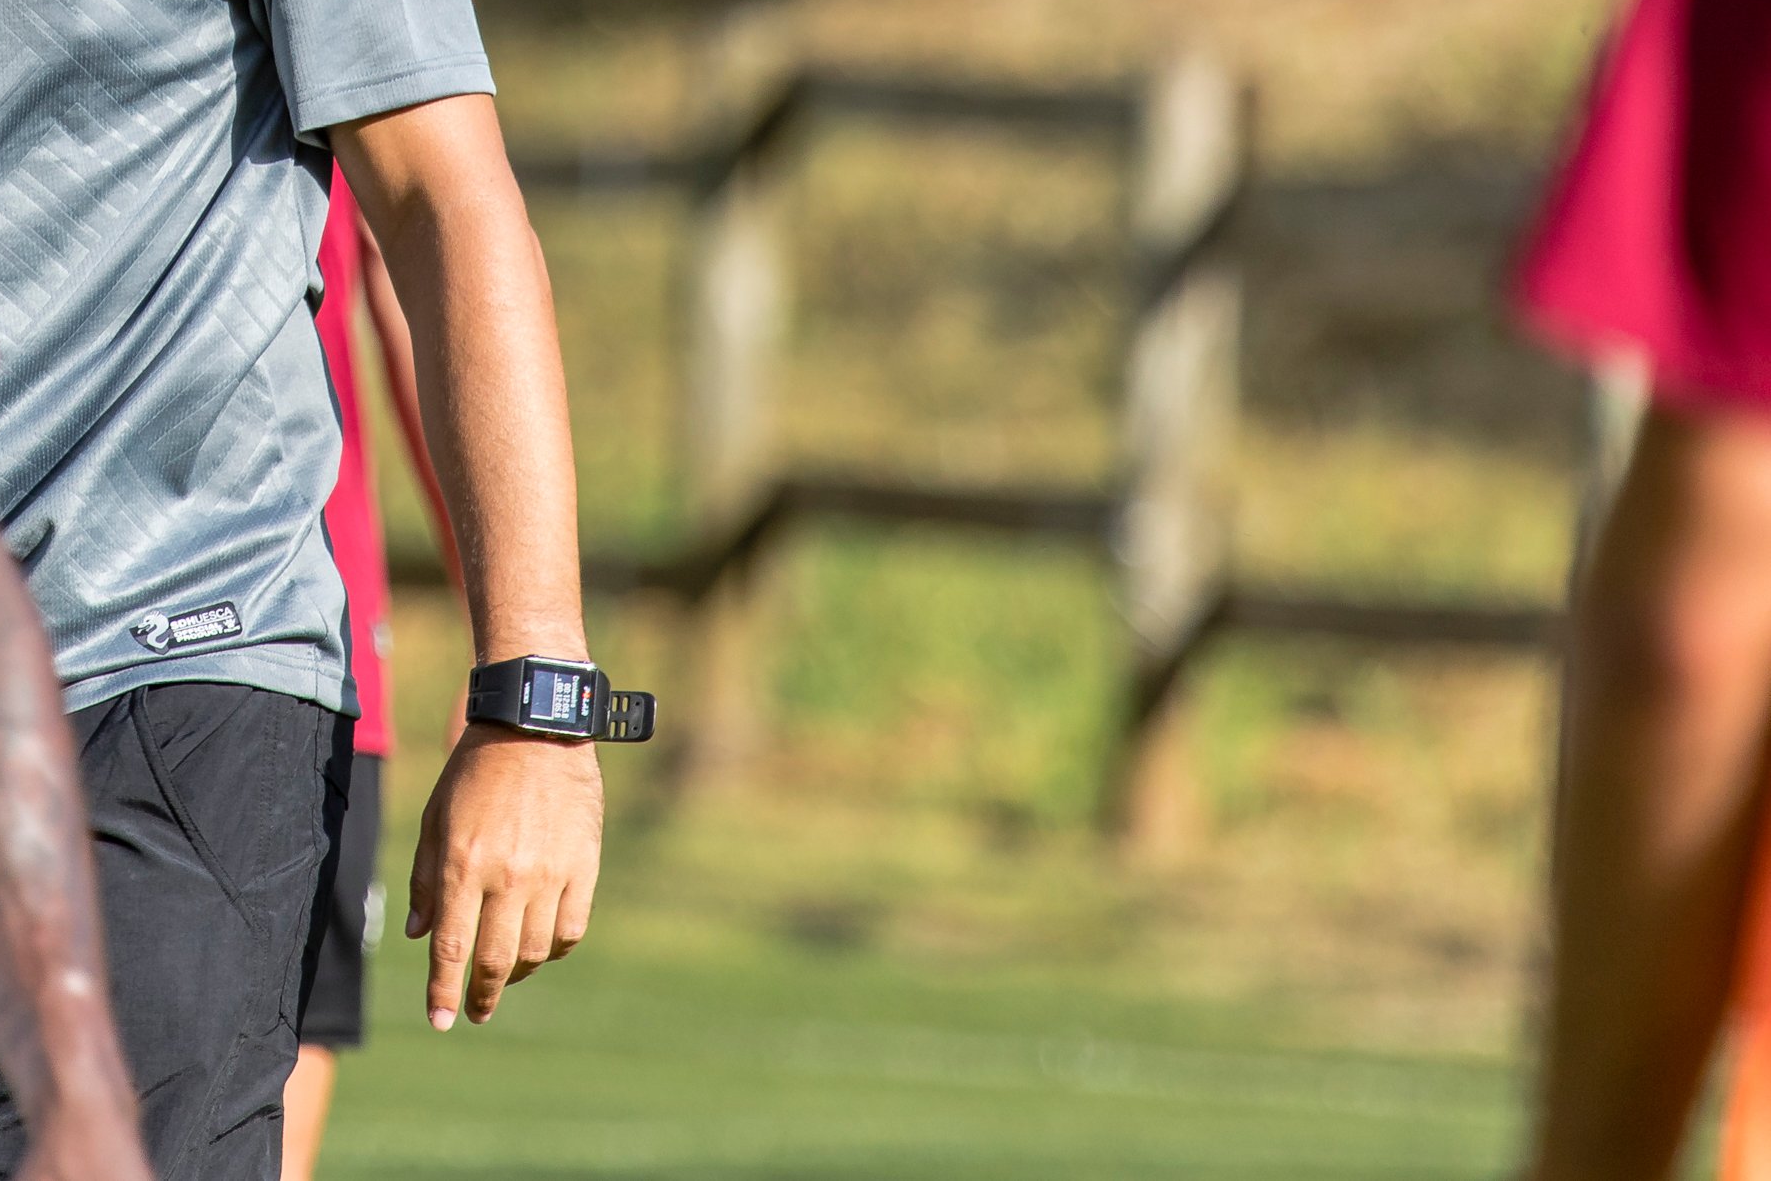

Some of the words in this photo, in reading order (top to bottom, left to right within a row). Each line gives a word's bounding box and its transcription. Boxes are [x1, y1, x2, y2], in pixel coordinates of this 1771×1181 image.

[173, 622, 221, 638] OFFICIAL
[176, 626, 224, 643] PRODUCT
[581, 685, 591, 717] POLAR
